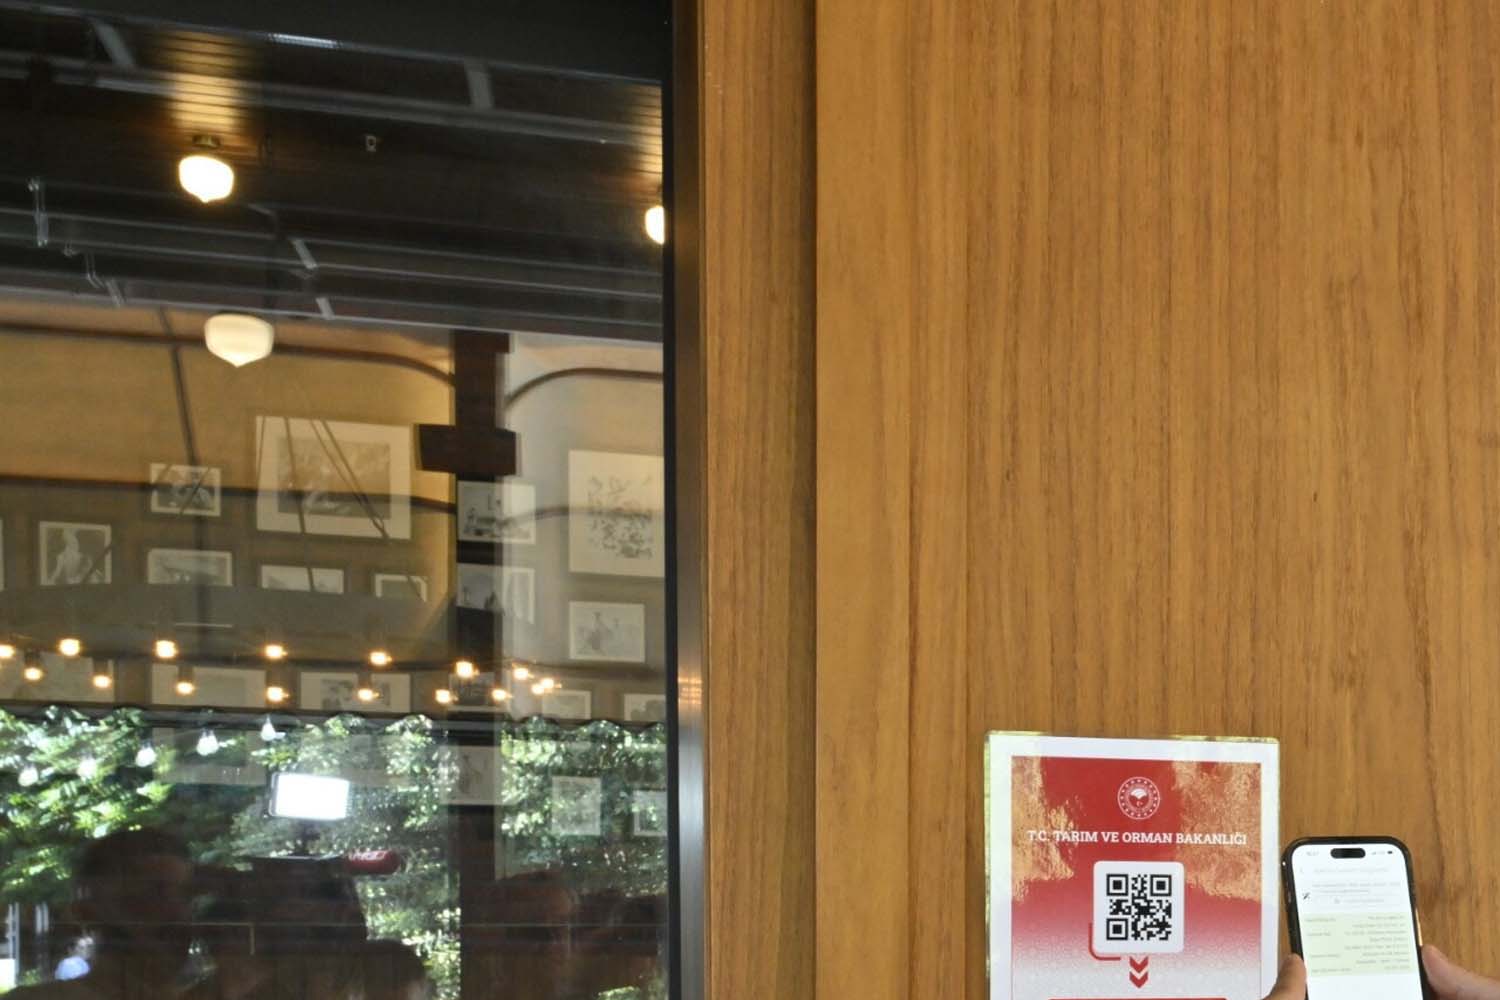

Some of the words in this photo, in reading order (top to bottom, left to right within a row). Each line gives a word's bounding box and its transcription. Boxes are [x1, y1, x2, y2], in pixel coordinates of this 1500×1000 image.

[1027, 830, 1050, 841] T.C.
[1053, 831, 1098, 843] TARIM
[1101, 832, 1119, 843] VE
[1122, 832, 1172, 844] ORMAN
[1175, 832, 1247, 845] BAKANLIĞI
